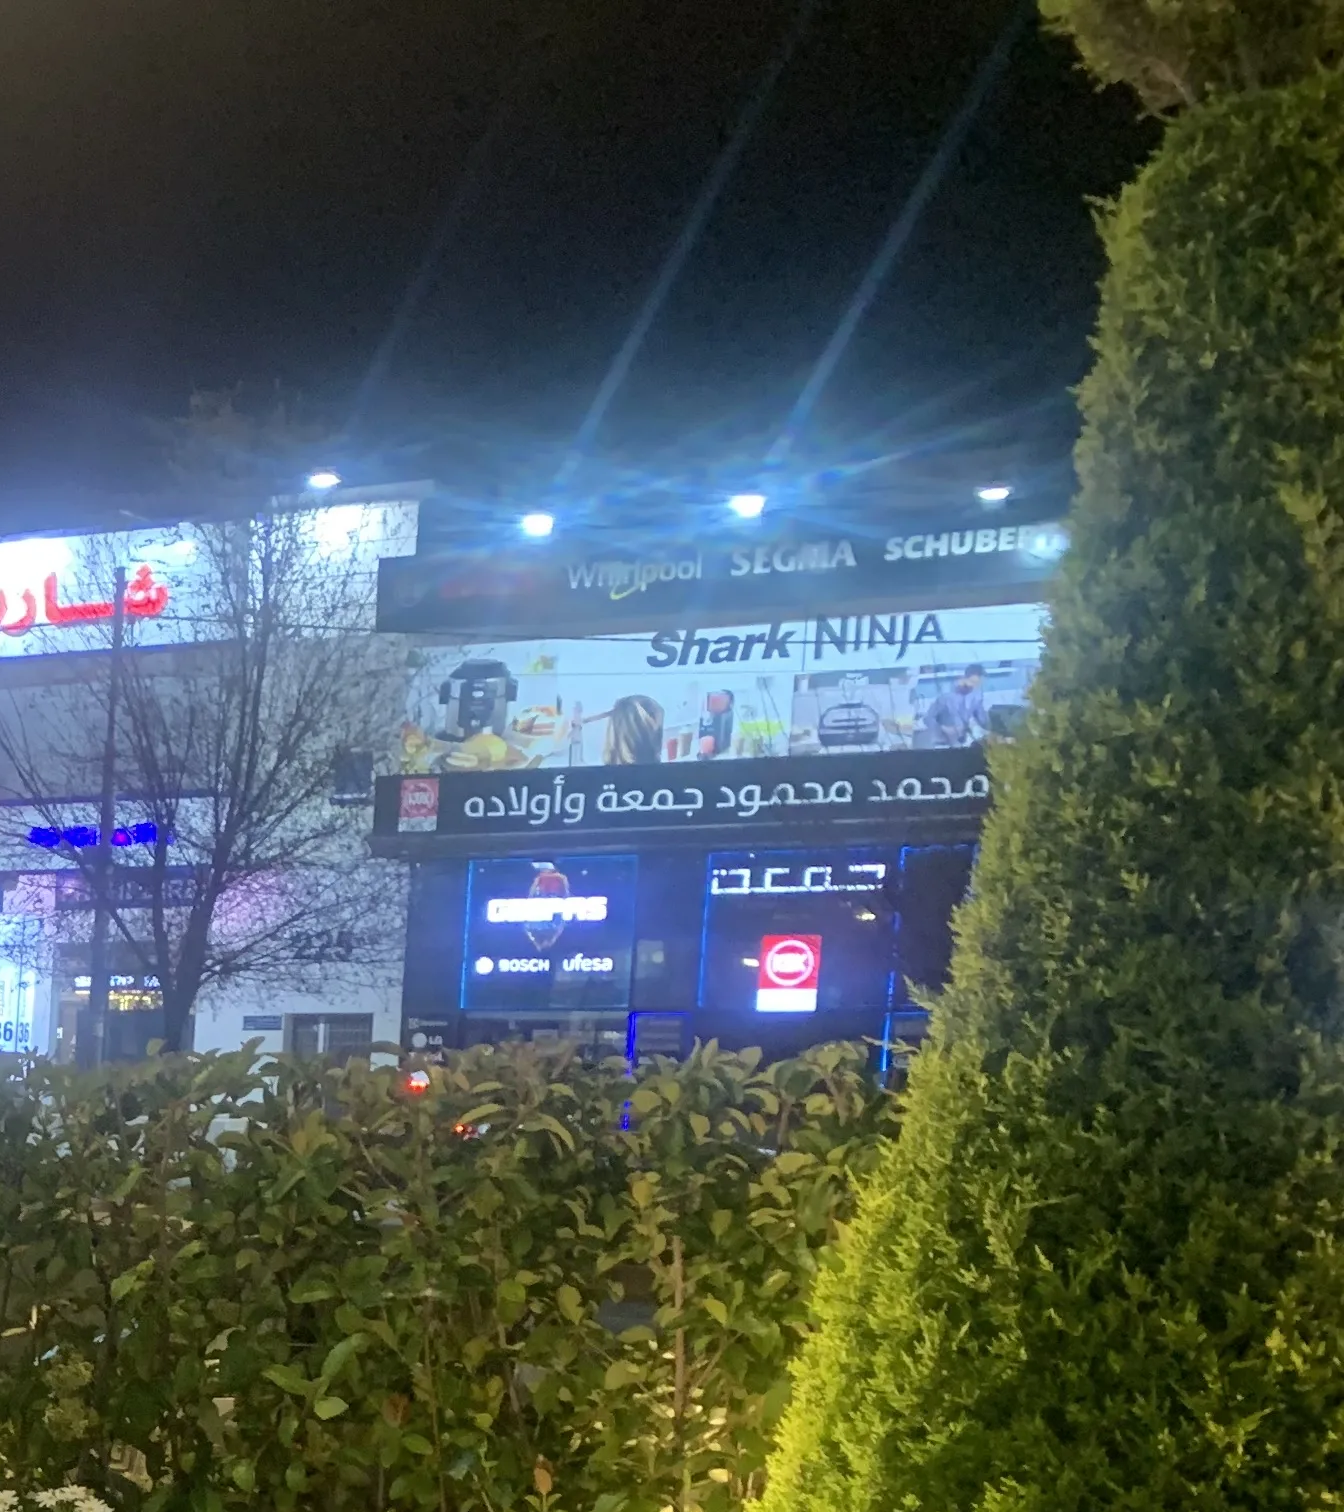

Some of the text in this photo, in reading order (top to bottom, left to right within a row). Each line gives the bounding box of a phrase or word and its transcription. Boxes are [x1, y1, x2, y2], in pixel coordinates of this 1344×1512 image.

[647, 612, 945, 668] Shark NINJA
[464, 774, 990, 825] محمد محمود جمعة وأولاده
[498, 953, 613, 972] BOSCH ufesa
